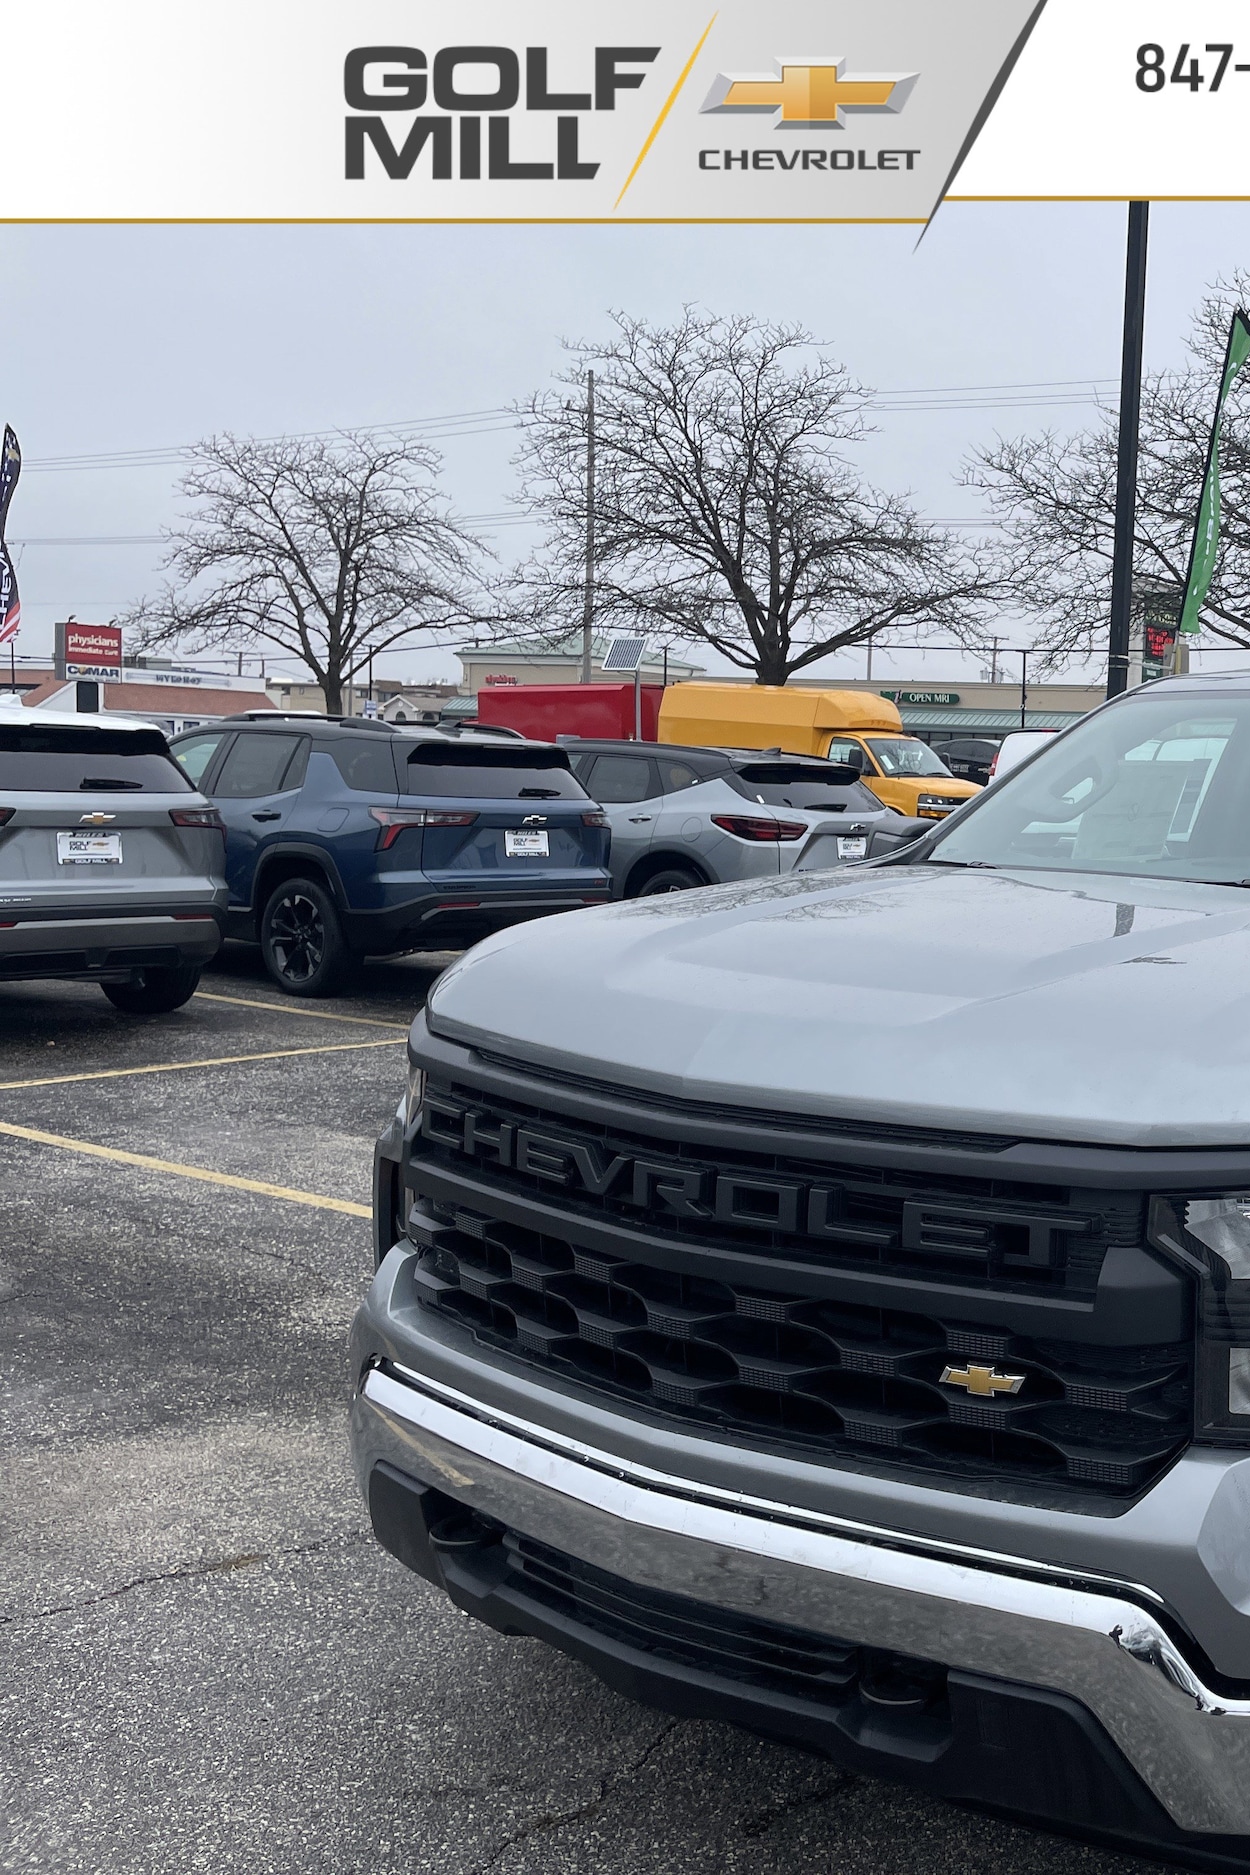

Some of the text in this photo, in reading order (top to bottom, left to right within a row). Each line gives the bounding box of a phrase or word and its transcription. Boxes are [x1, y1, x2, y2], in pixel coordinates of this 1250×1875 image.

[68, 633, 119, 647] physicians
[909, 693, 950, 703] OPEN MRI
[421, 1098, 1093, 1270] CHEVROLET
